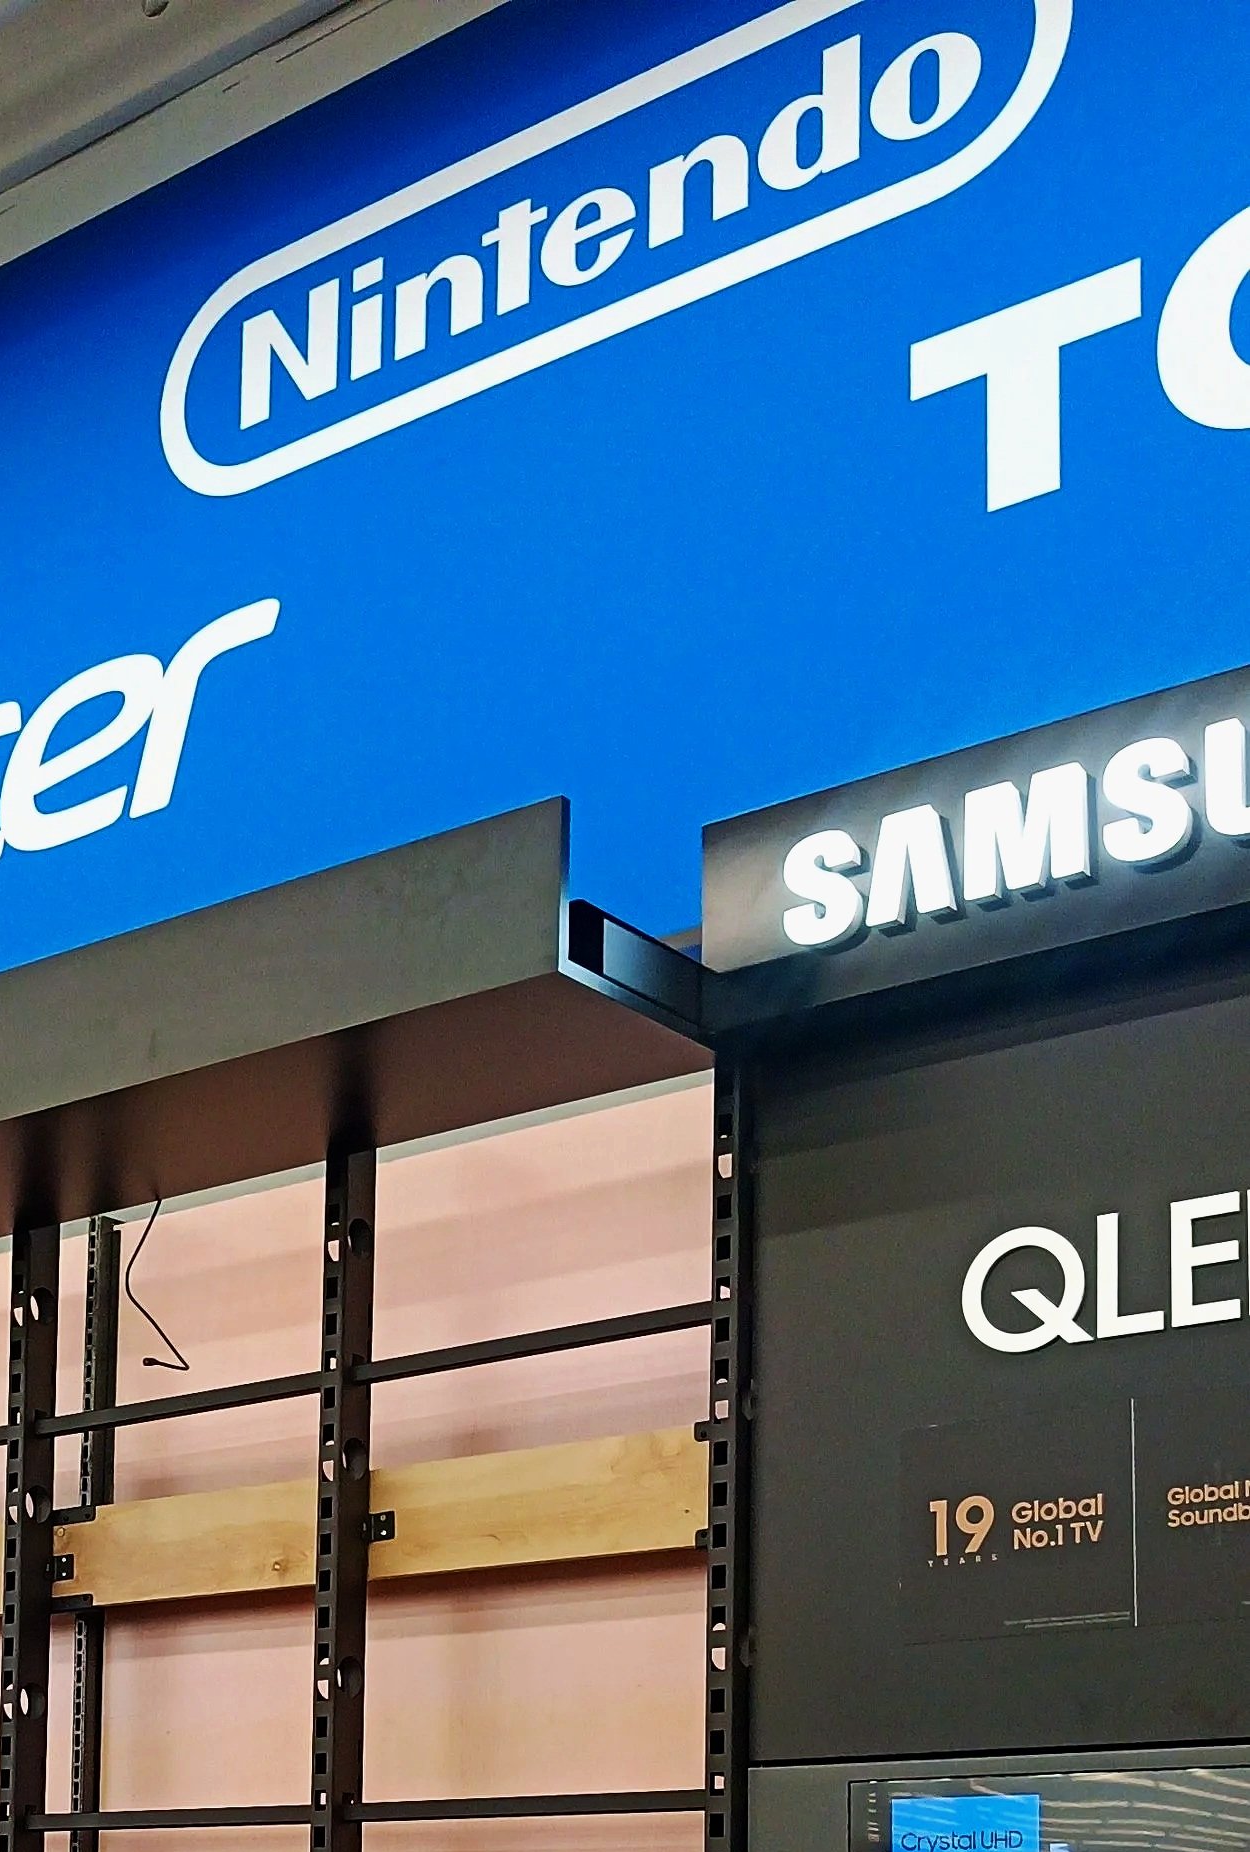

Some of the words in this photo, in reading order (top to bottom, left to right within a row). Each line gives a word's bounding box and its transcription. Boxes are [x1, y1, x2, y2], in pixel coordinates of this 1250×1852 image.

[240, 32, 982, 430] Nintendo
[961, 1190, 1250, 1353] QLE
[1011, 1493, 1104, 1524] Global
[1167, 1480, 1240, 1506] Global
[929, 1495, 996, 1557] 19
[1012, 1524, 1064, 1551] No.1
[1070, 1520, 1104, 1545] TV
[980, 1829, 1023, 1850] UHD
